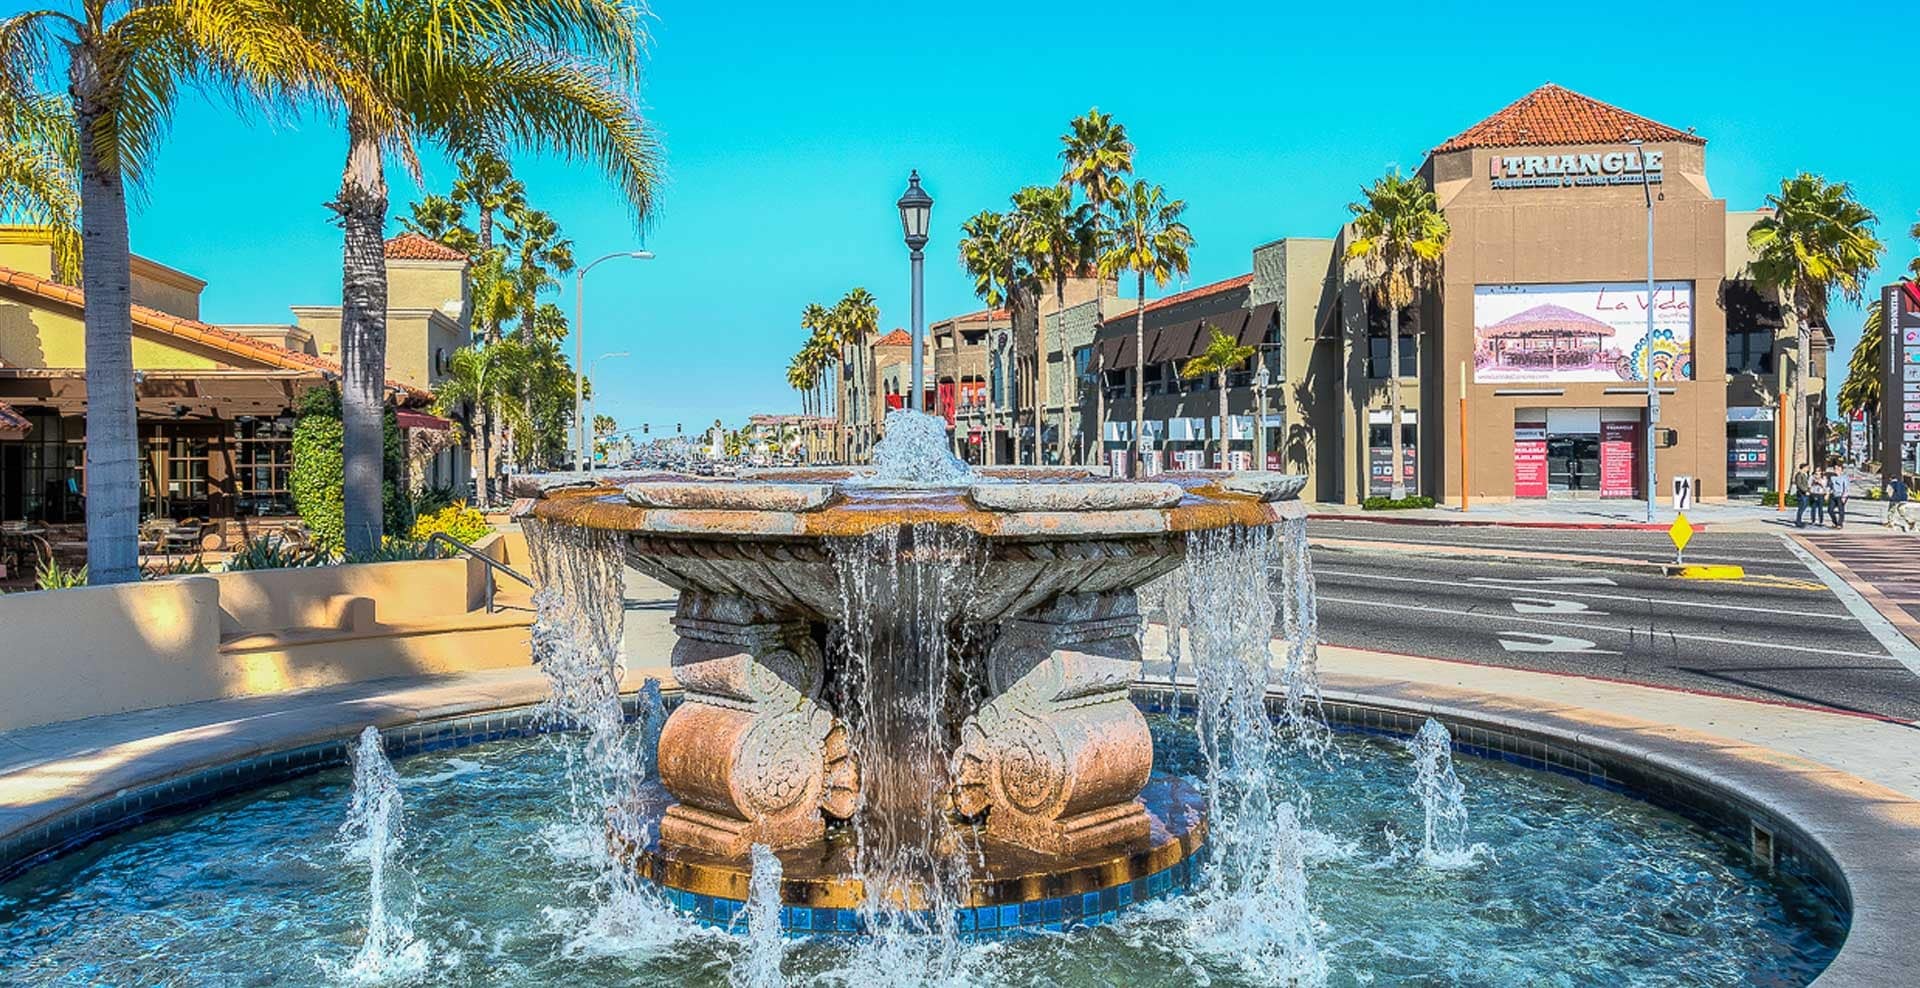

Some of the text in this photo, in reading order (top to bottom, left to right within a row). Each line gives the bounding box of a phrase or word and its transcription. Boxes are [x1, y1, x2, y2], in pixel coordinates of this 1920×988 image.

[1503, 151, 1663, 176] TRIANGLE
[1596, 286, 1690, 310] La Vida
